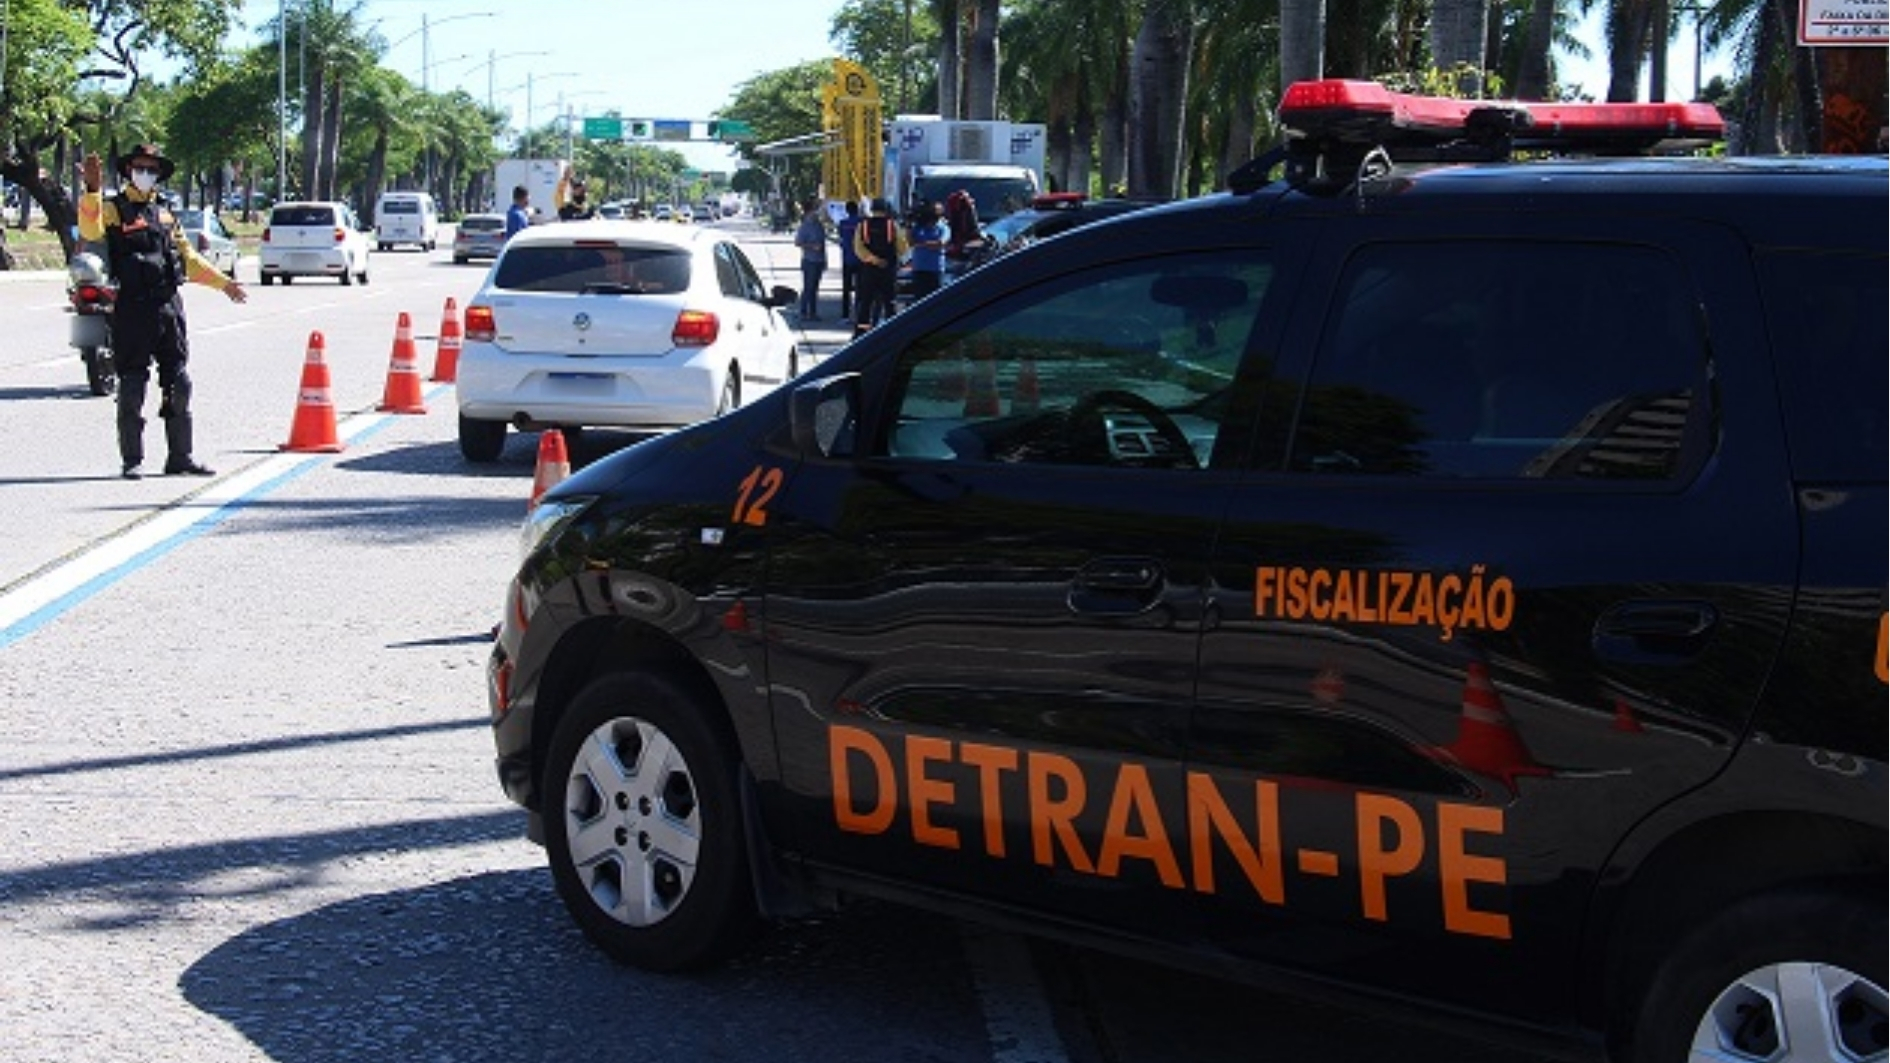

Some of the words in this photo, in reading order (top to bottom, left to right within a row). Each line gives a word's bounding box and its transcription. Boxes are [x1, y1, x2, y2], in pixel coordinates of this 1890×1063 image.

[732, 465, 784, 526] 12
[1255, 564, 1515, 641] FISCALIZAÇÃO
[829, 725, 1512, 940] DETRAN-PE
